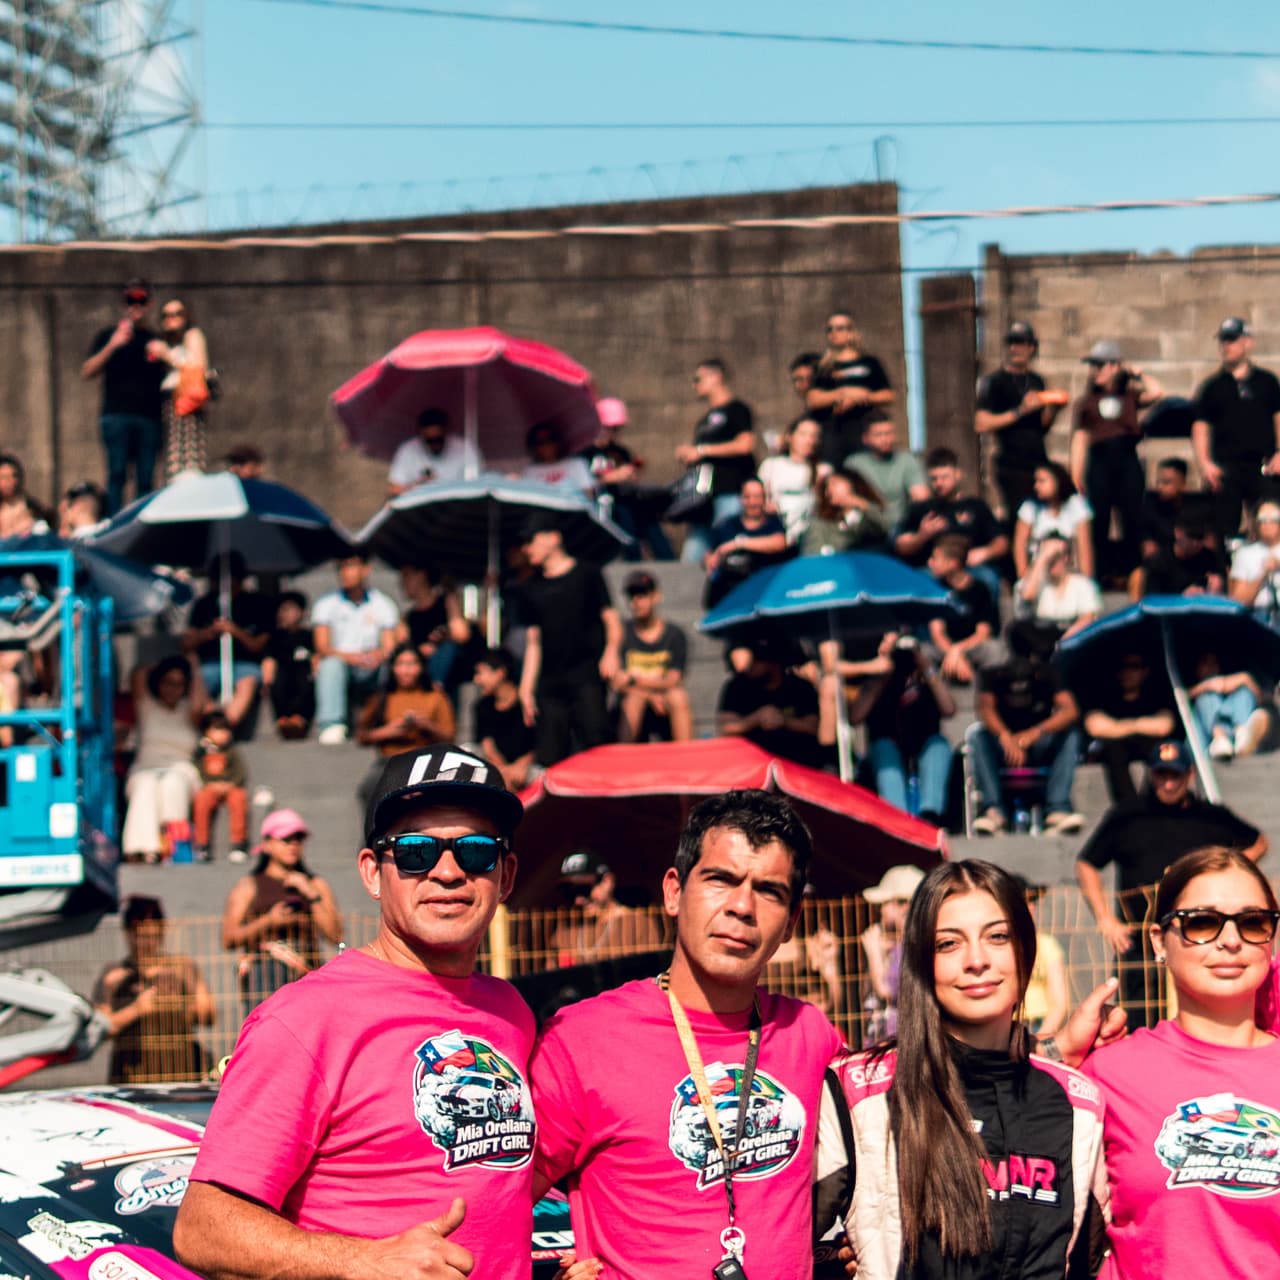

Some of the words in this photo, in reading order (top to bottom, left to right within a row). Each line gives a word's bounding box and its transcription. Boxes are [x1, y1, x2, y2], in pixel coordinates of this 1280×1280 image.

[455, 1123, 483, 1145] Mia
[484, 1119, 532, 1138] Orellana
[738, 1128, 793, 1151] Orellana
[452, 1137, 501, 1163] DRIFT
[501, 1134, 532, 1151] GIRL
[754, 1143, 792, 1166] GIRL
[1176, 1166, 1239, 1183] DRIFT
